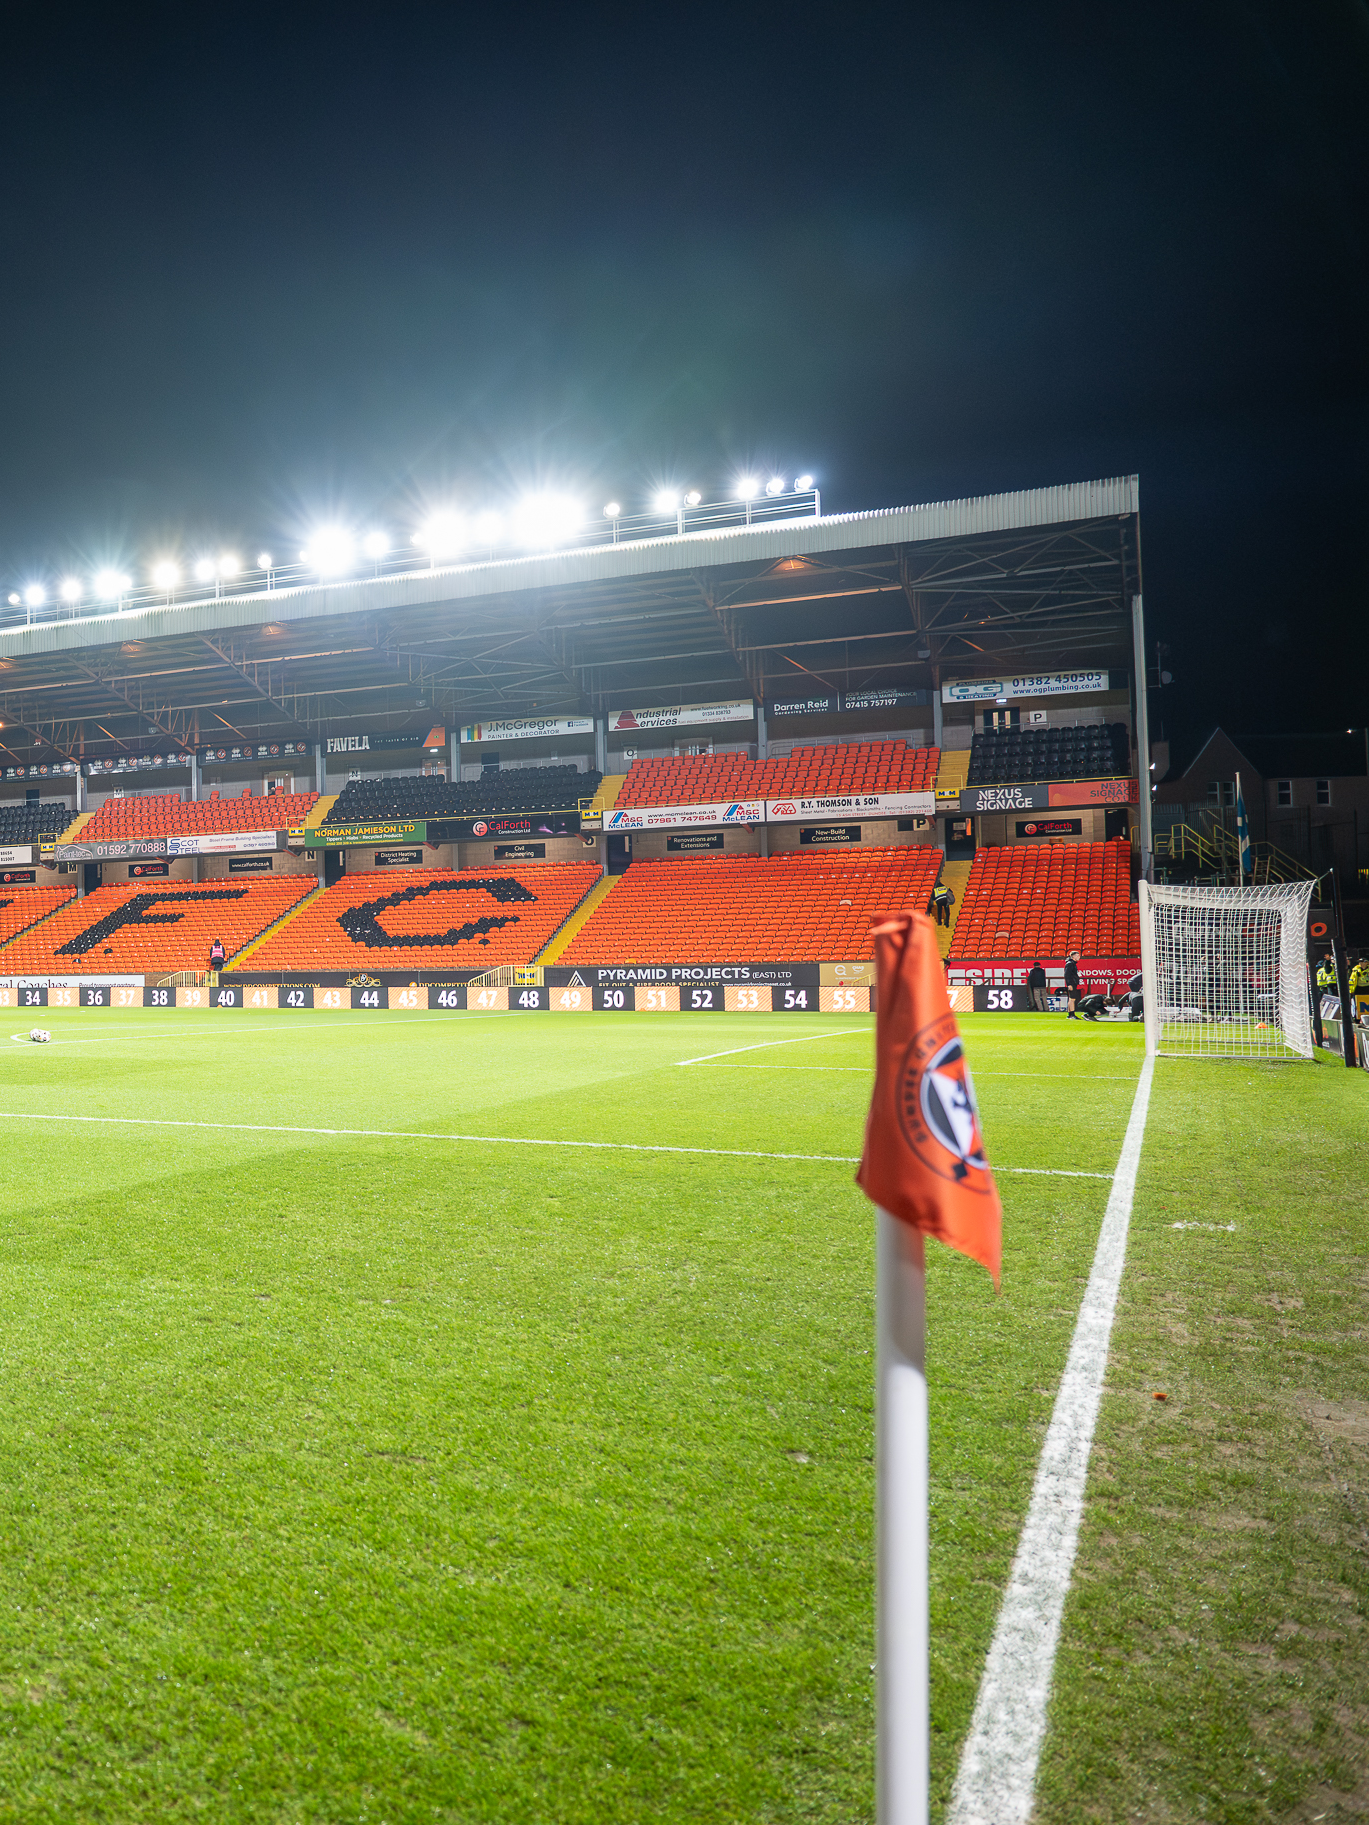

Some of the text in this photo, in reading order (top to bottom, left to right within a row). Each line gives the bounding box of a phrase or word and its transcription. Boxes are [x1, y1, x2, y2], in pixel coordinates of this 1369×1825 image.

[1012, 671, 1102, 688] 01382 450505
[1012, 682, 1102, 695] www.ogplumbing.co.uk
[774, 700, 829, 712] Darren Reid
[845, 699, 897, 709] 07415 757197
[1033, 713, 1043, 722] P
[488, 719, 559, 733] J.McGregor
[521, 729, 560, 737] DECORATOR
[326, 736, 370, 753] FAVELA
[978, 788, 1022, 800] NEXUS
[801, 797, 879, 809] R.Y. THOMSON & SON
[976, 798, 1033, 811] SIGNAGE
[489, 820, 531, 831] CalForth
[723, 814, 760, 822] McLEAN
[916, 819, 926, 829] P
[314, 825, 415, 838] NORMAN JAMIESON LTD
[1038, 822, 1072, 831] CalForth
[97, 842, 166, 856] 01592 770888
[169, 846, 203, 855] STEEL
[171, 839, 199, 847] SCOT
[307, 851, 315, 860] N
[505, 851, 534, 859] Engineering
[598, 967, 792, 980] PYRAMID PROJECTS (EAST) LTD
[966, 969, 1031, 986] SIDE
[17, 979, 68, 988] Coaches
[25, 990, 41, 1005] 34
[56, 990, 71, 1005] 35
[87, 990, 103, 1005] 36
[119, 990, 135, 1005] 37
[151, 990, 168, 1005] 38
[184, 990, 201, 1006] 39
[217, 990, 235, 1006] 40
[252, 991, 268, 1006] 41
[286, 991, 304, 1006] 42
[323, 991, 341, 1007] 43
[360, 991, 380, 1007] 44
[398, 991, 417, 1007] 45
[437, 990, 458, 1007] 46
[477, 991, 497, 1007] 47
[518, 991, 540, 1007] 48
[560, 991, 581, 1008] 49
[603, 990, 624, 1008] 50
[646, 991, 667, 1008] 51
[691, 990, 713, 1008] 52
[737, 990, 759, 1008] 53
[784, 990, 807, 1008] 54
[832, 991, 856, 1008] 55
[987, 990, 1013, 1009] 58
